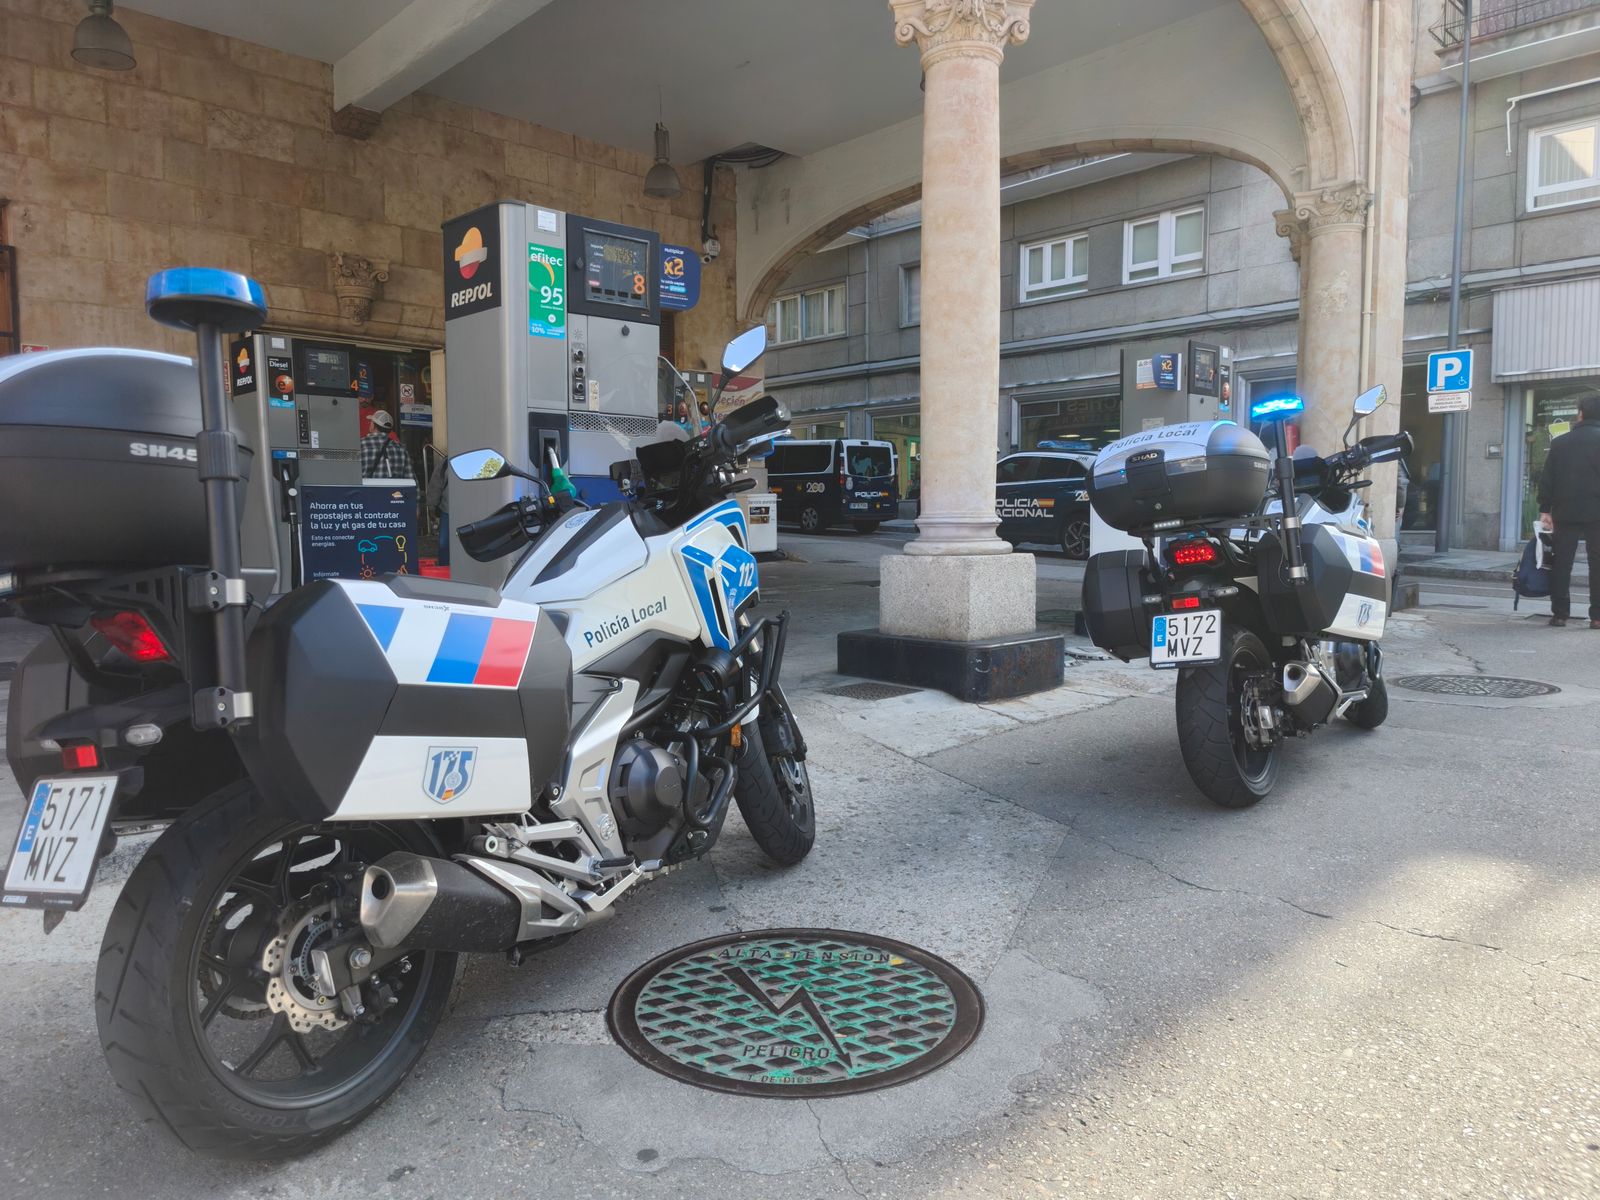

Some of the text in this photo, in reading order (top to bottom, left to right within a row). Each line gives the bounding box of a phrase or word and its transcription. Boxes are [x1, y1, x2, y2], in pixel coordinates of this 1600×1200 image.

[530, 252, 563, 267] efitec
[664, 258, 684, 276] x2
[633, 273, 646, 294] 8
[450, 282, 492, 308] REPSOL
[540, 285, 563, 306] 95
[269, 360, 289, 369] Diesel
[1436, 357, 1462, 387] P
[350, 380, 360, 391] 4
[1157, 428, 1198, 439] Local
[1131, 452, 1158, 463] SHAD
[806, 482, 826, 493] 200
[310, 502, 337, 510] Ahorra
[996, 498, 1040, 508] OLICIA
[310, 512, 352, 520] repostajes
[354, 512, 362, 520] al
[996, 508, 1054, 518] ACIONAL
[738, 562, 756, 587] 112
[584, 596, 668, 648] Policía Local
[1168, 614, 1216, 637] 5172
[1168, 636, 1203, 658] MVZ
[42, 786, 106, 831] 5171
[24, 824, 34, 840] E
[24, 836, 78, 882] MVZ
[718, 948, 891, 963] ALTA TENSION
[742, 1044, 831, 1060] PELIGRO
